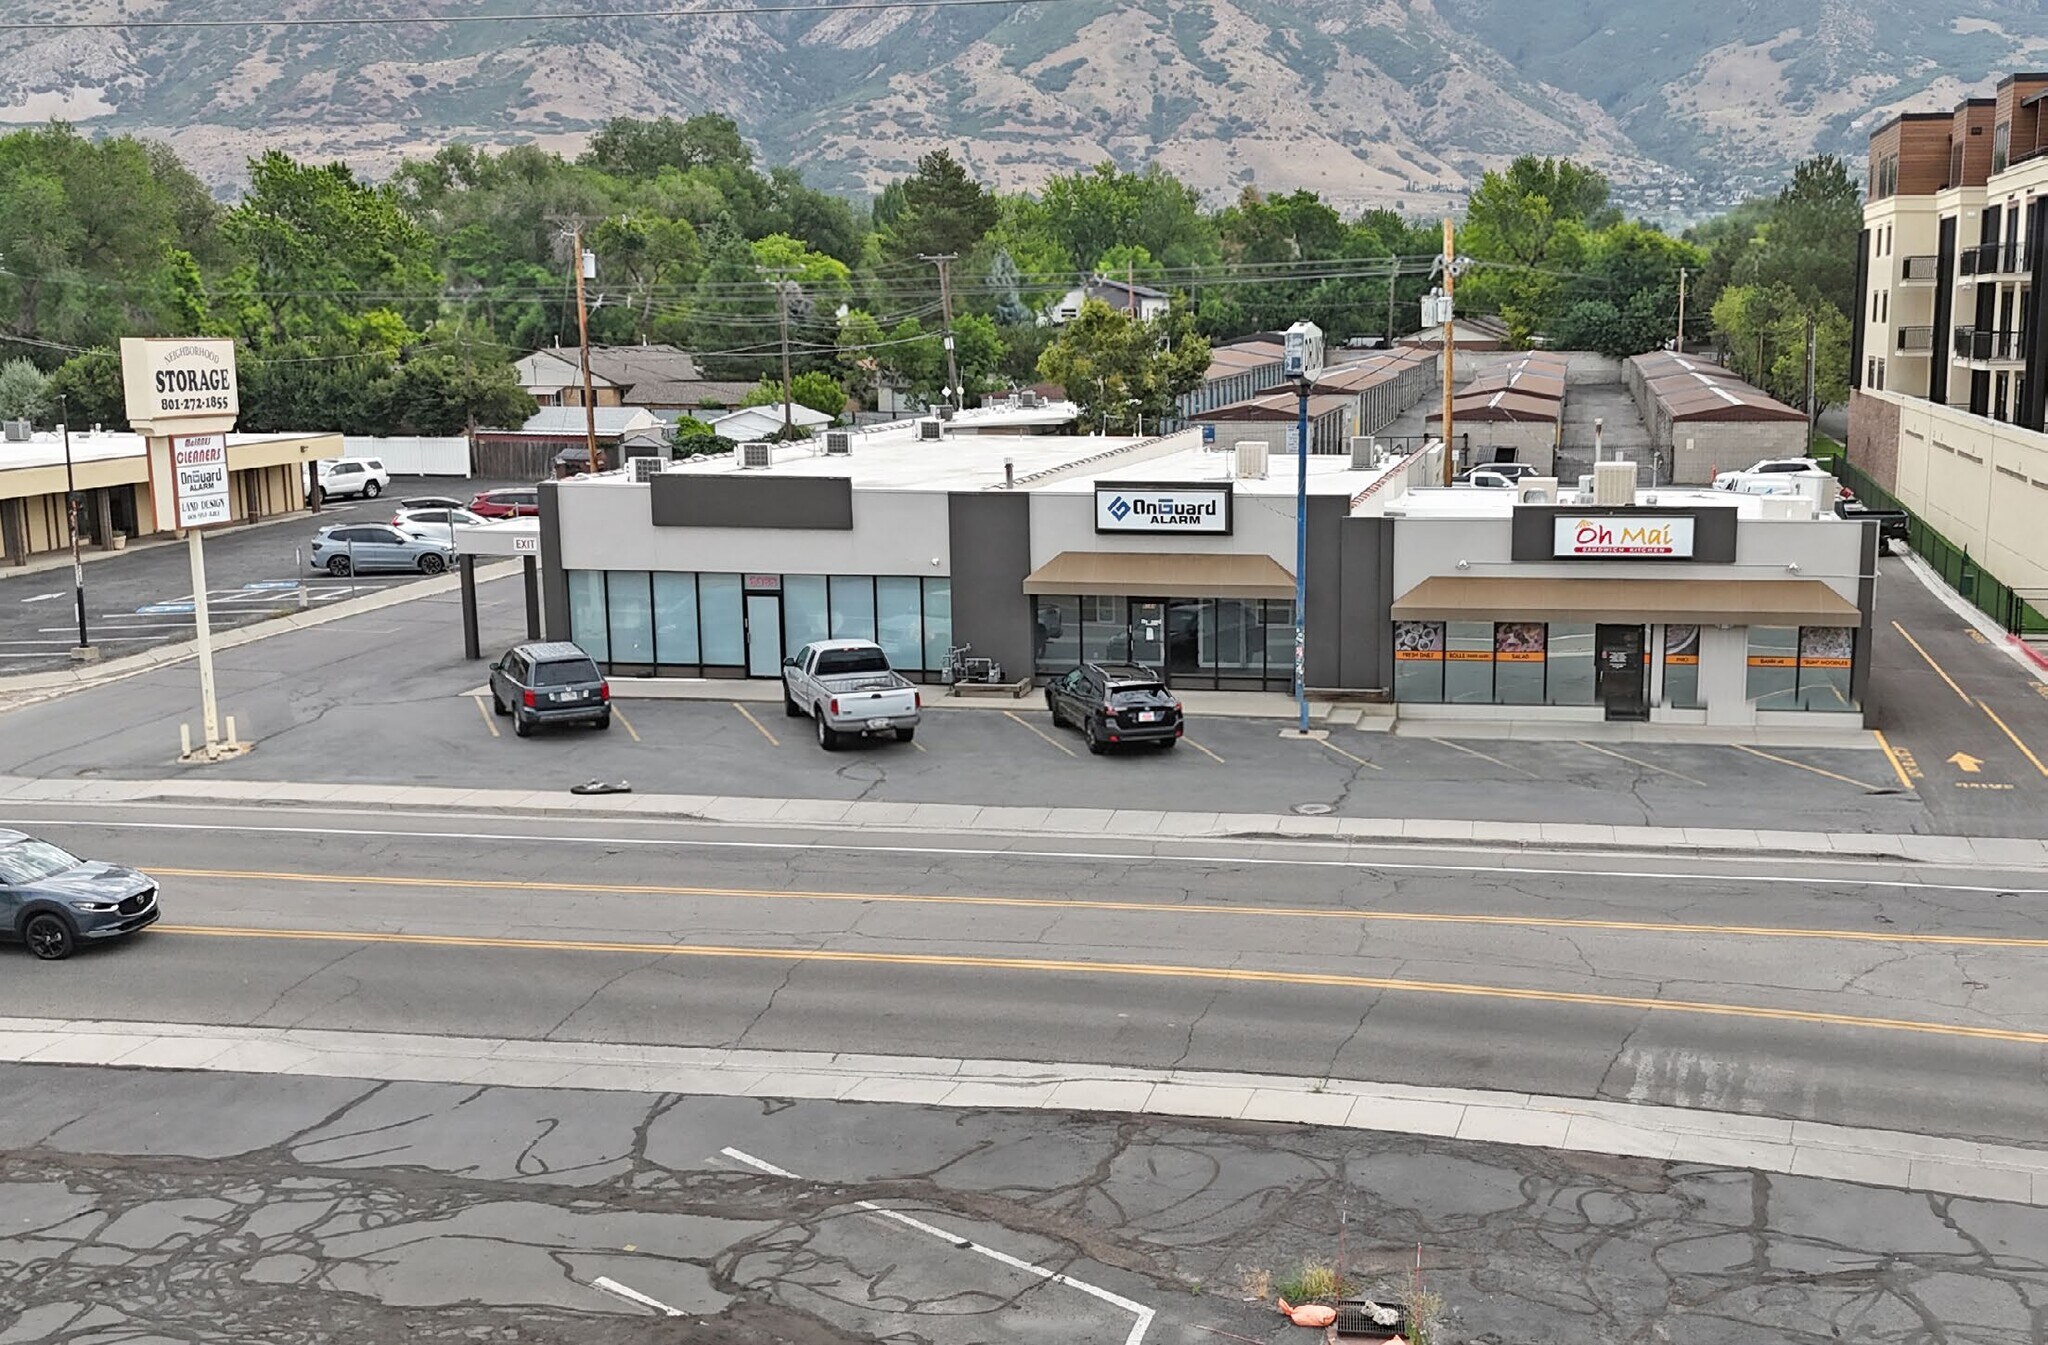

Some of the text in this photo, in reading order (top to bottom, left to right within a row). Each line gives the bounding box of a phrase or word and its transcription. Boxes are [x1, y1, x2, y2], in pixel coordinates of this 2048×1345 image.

[164, 345, 220, 365] NEIGHBORHOOD
[155, 369, 230, 393] STORAGE
[161, 396, 228, 411] 801-272-1855
[176, 448, 222, 464] CLEANERS
[180, 468, 222, 485] OnGuard
[189, 482, 215, 492] ALARM
[181, 498, 225, 513] LAND DESIGN
[1133, 498, 1216, 516] OnGuard
[1150, 515, 1201, 525] ALARM
[516, 539, 535, 549] EXIT
